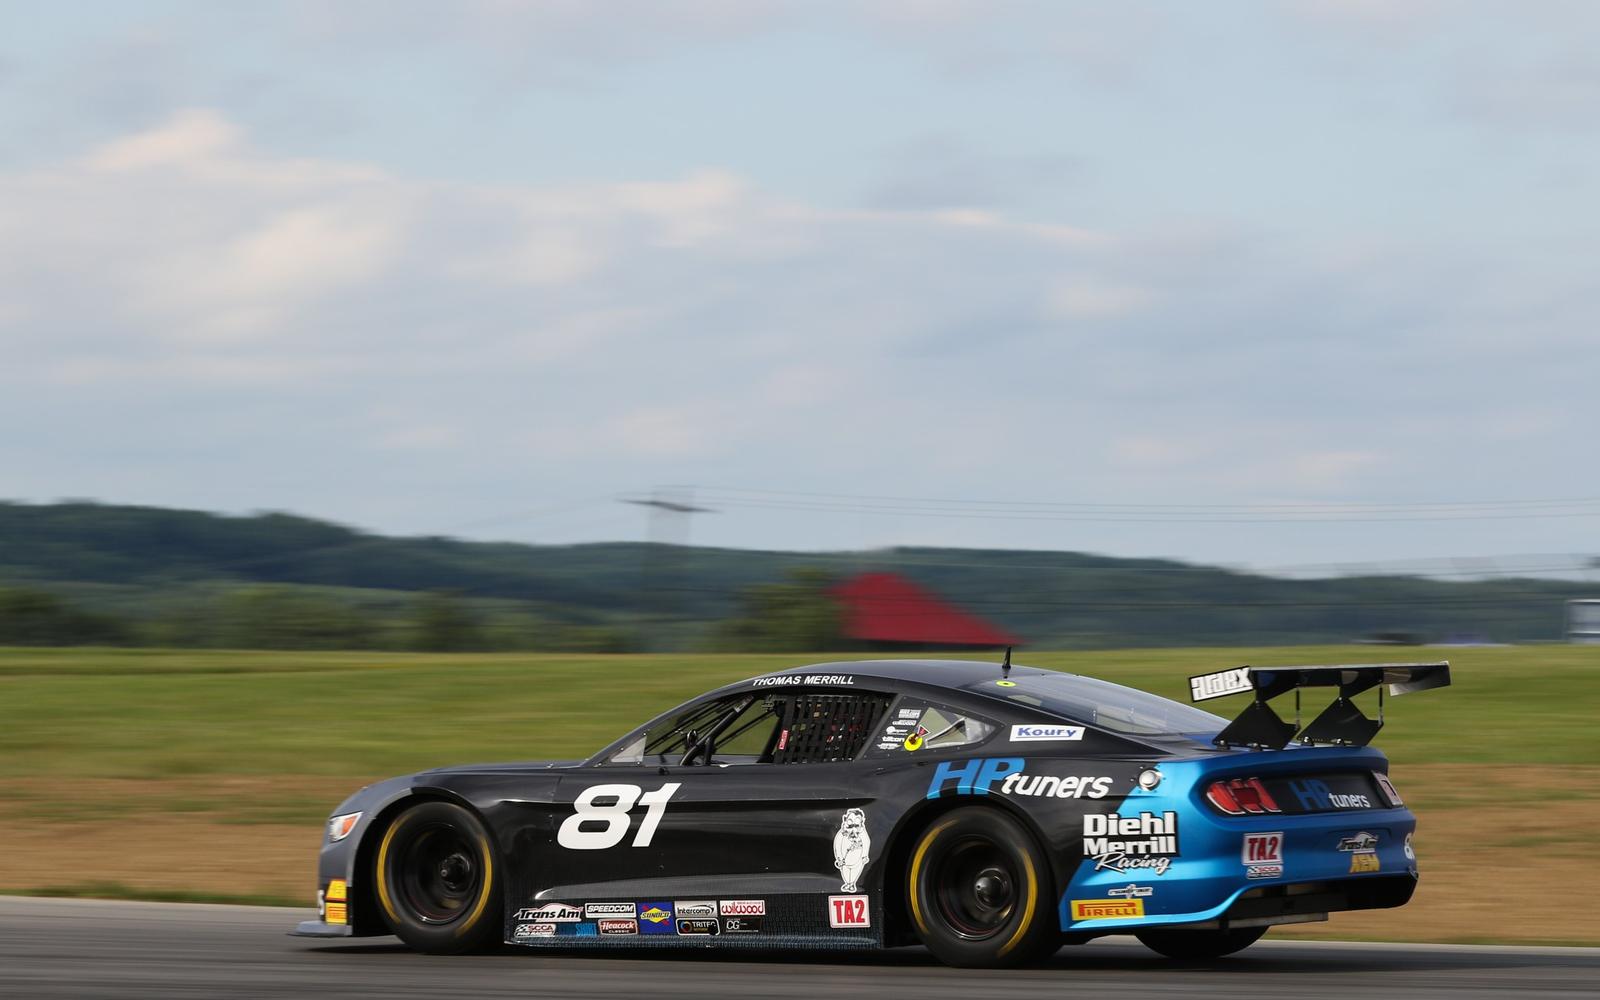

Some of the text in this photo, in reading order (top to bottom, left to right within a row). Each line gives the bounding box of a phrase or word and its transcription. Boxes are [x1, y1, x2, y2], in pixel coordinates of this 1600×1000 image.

[752, 675, 854, 686] THOMAS MERRILL
[1017, 726, 1077, 738] Koury
[557, 782, 682, 850] 81
[1083, 811, 1176, 836] Diehl
[1083, 836, 1177, 855] Merrill
[1248, 836, 1279, 861] TA2
[1091, 851, 1172, 876] Racing
[517, 908, 581, 919] Trans Am
[587, 905, 634, 914] SPEEDCOM
[677, 907, 711, 916] Intercomp
[721, 901, 764, 914] wilwood
[833, 899, 865, 924] TA2
[1077, 902, 1138, 917] PIRELLI
[642, 911, 670, 920] SUNOCO
[601, 921, 634, 930] Heacock
[726, 920, 740, 930] CG
